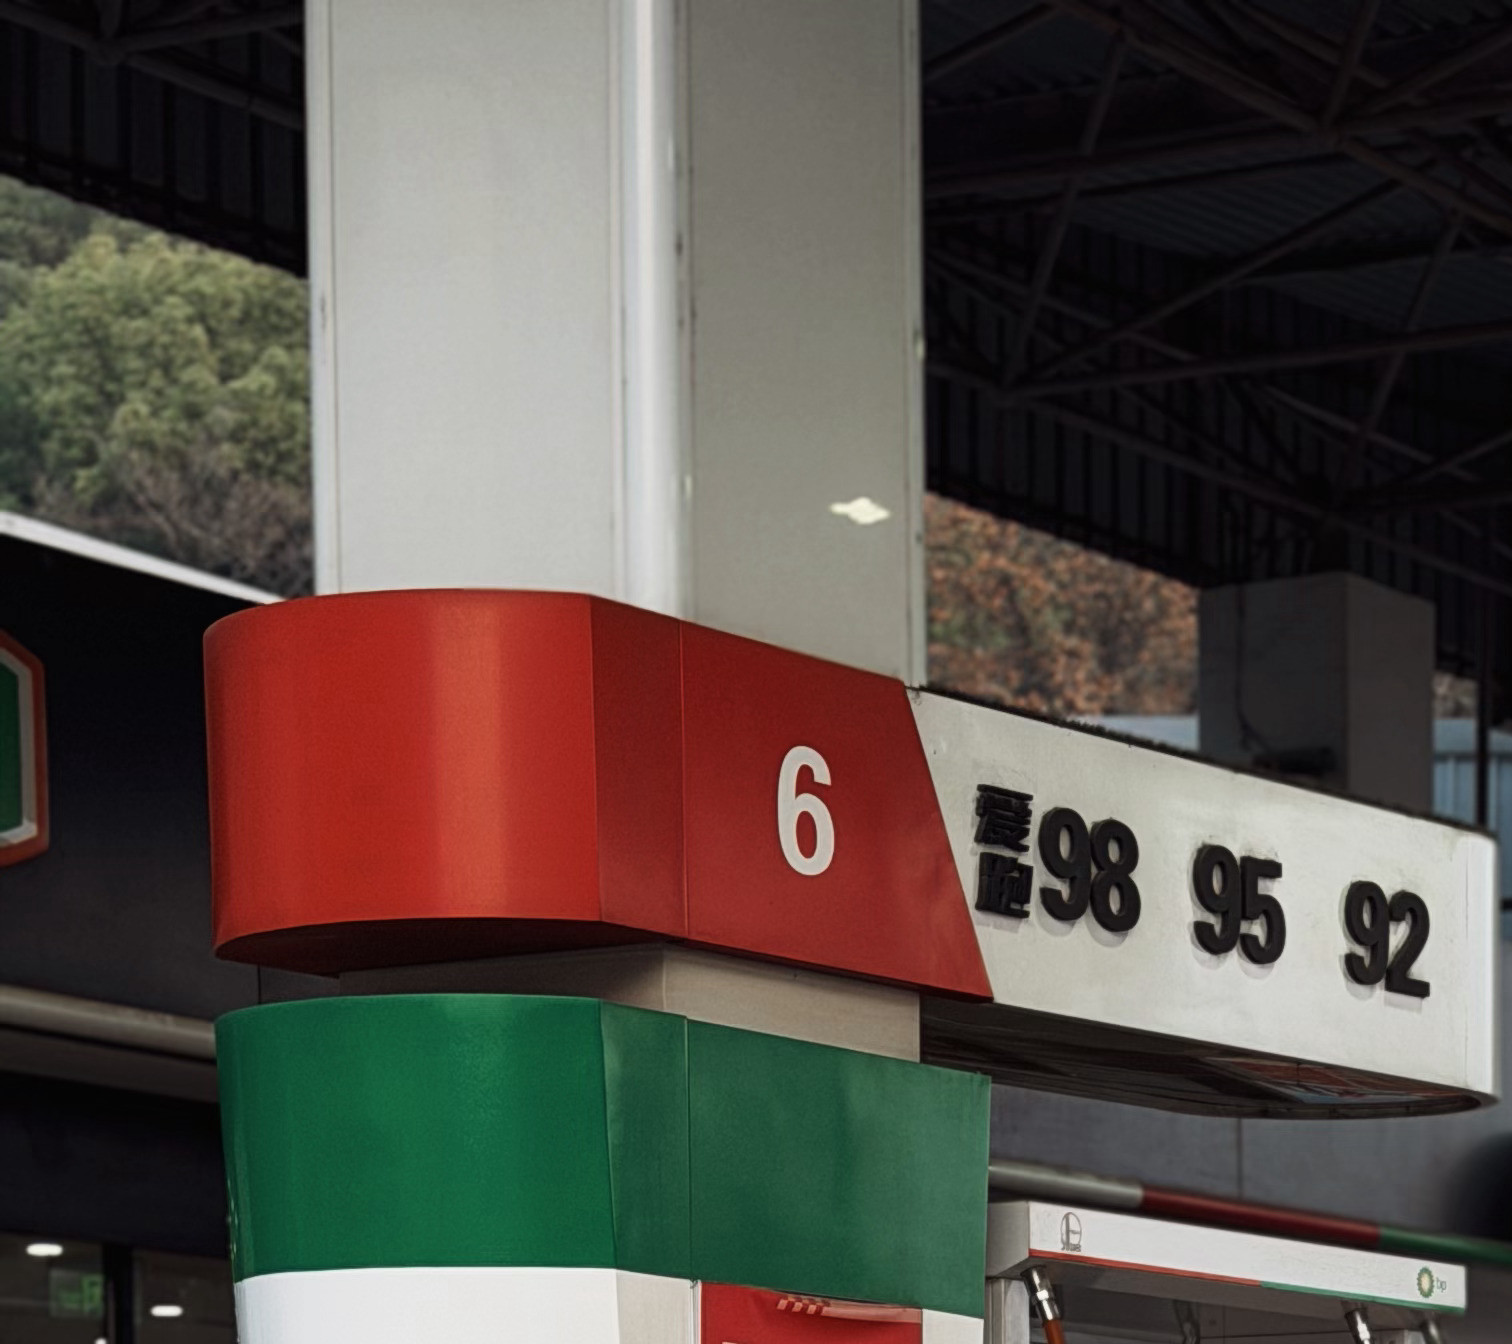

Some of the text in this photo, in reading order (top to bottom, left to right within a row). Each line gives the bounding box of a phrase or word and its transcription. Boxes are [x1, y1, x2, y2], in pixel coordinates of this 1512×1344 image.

[777, 745, 836, 876] 6
[975, 783, 1431, 999] 爱跑 98 95 92
